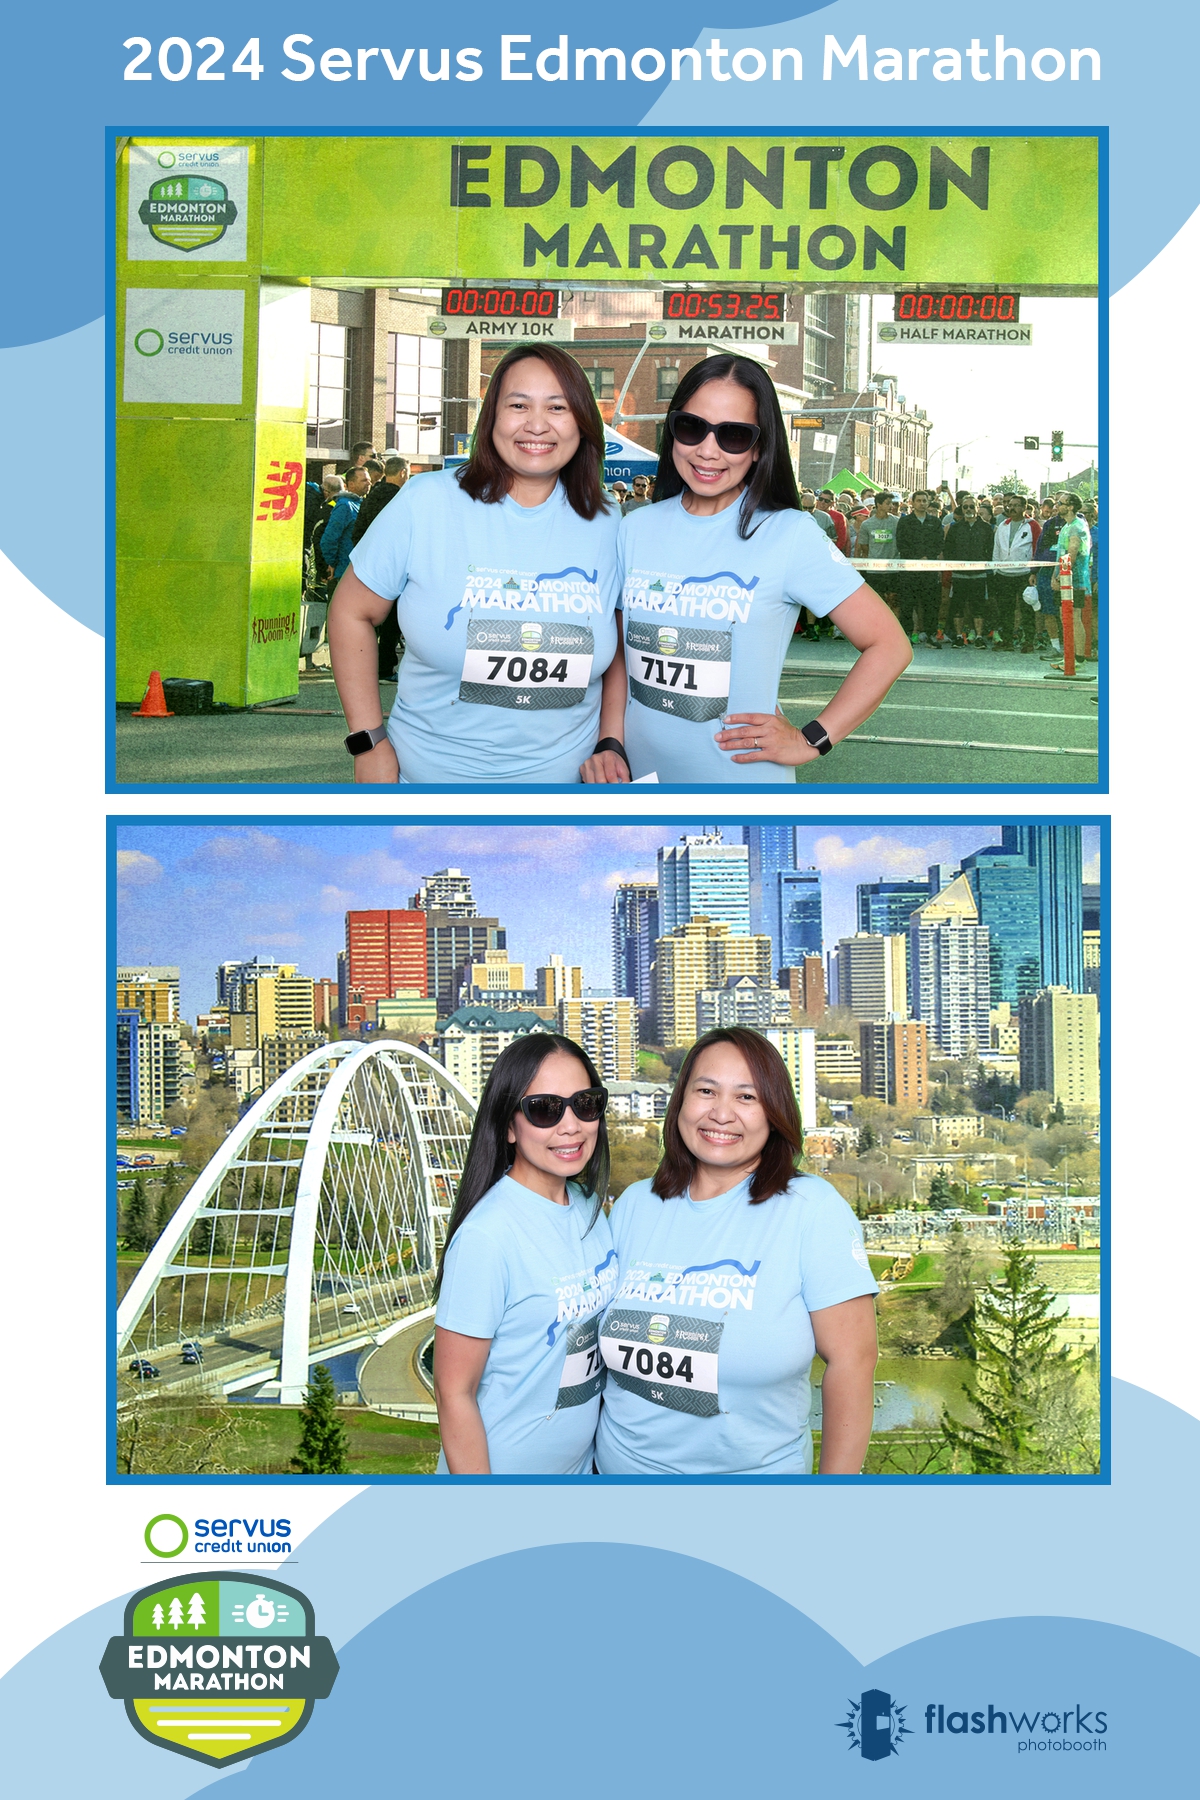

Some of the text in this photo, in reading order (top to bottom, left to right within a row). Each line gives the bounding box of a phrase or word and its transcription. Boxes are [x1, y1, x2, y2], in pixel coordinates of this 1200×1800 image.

[178, 152, 220, 161] servus
[450, 145, 991, 211] EDMONTON
[149, 202, 227, 214] EDMONTON
[160, 214, 216, 223] MARATHON
[523, 222, 907, 272] MARATHON
[466, 321, 554, 336] ARMY 10K
[678, 325, 785, 340] MARATHON
[900, 328, 939, 340] HALF
[943, 328, 1031, 341] MARATHON
[168, 331, 233, 345] servus
[168, 345, 233, 355] credit union
[465, 575, 600, 595] 2024 EDMONTON
[664, 582, 755, 603] EDMONTON
[460, 588, 603, 614] MARATHON
[622, 587, 752, 624] MARATHON
[487, 655, 569, 683] 7084
[641, 656, 698, 691] 7171
[515, 695, 532, 704] 5K
[662, 698, 674, 709] 5K
[664, 1272, 757, 1289] EDMONTON
[555, 1283, 584, 1301] 2024
[614, 1281, 755, 1311] MARATHON
[618, 1345, 694, 1383] 7084
[651, 1389, 664, 1401] 5K
